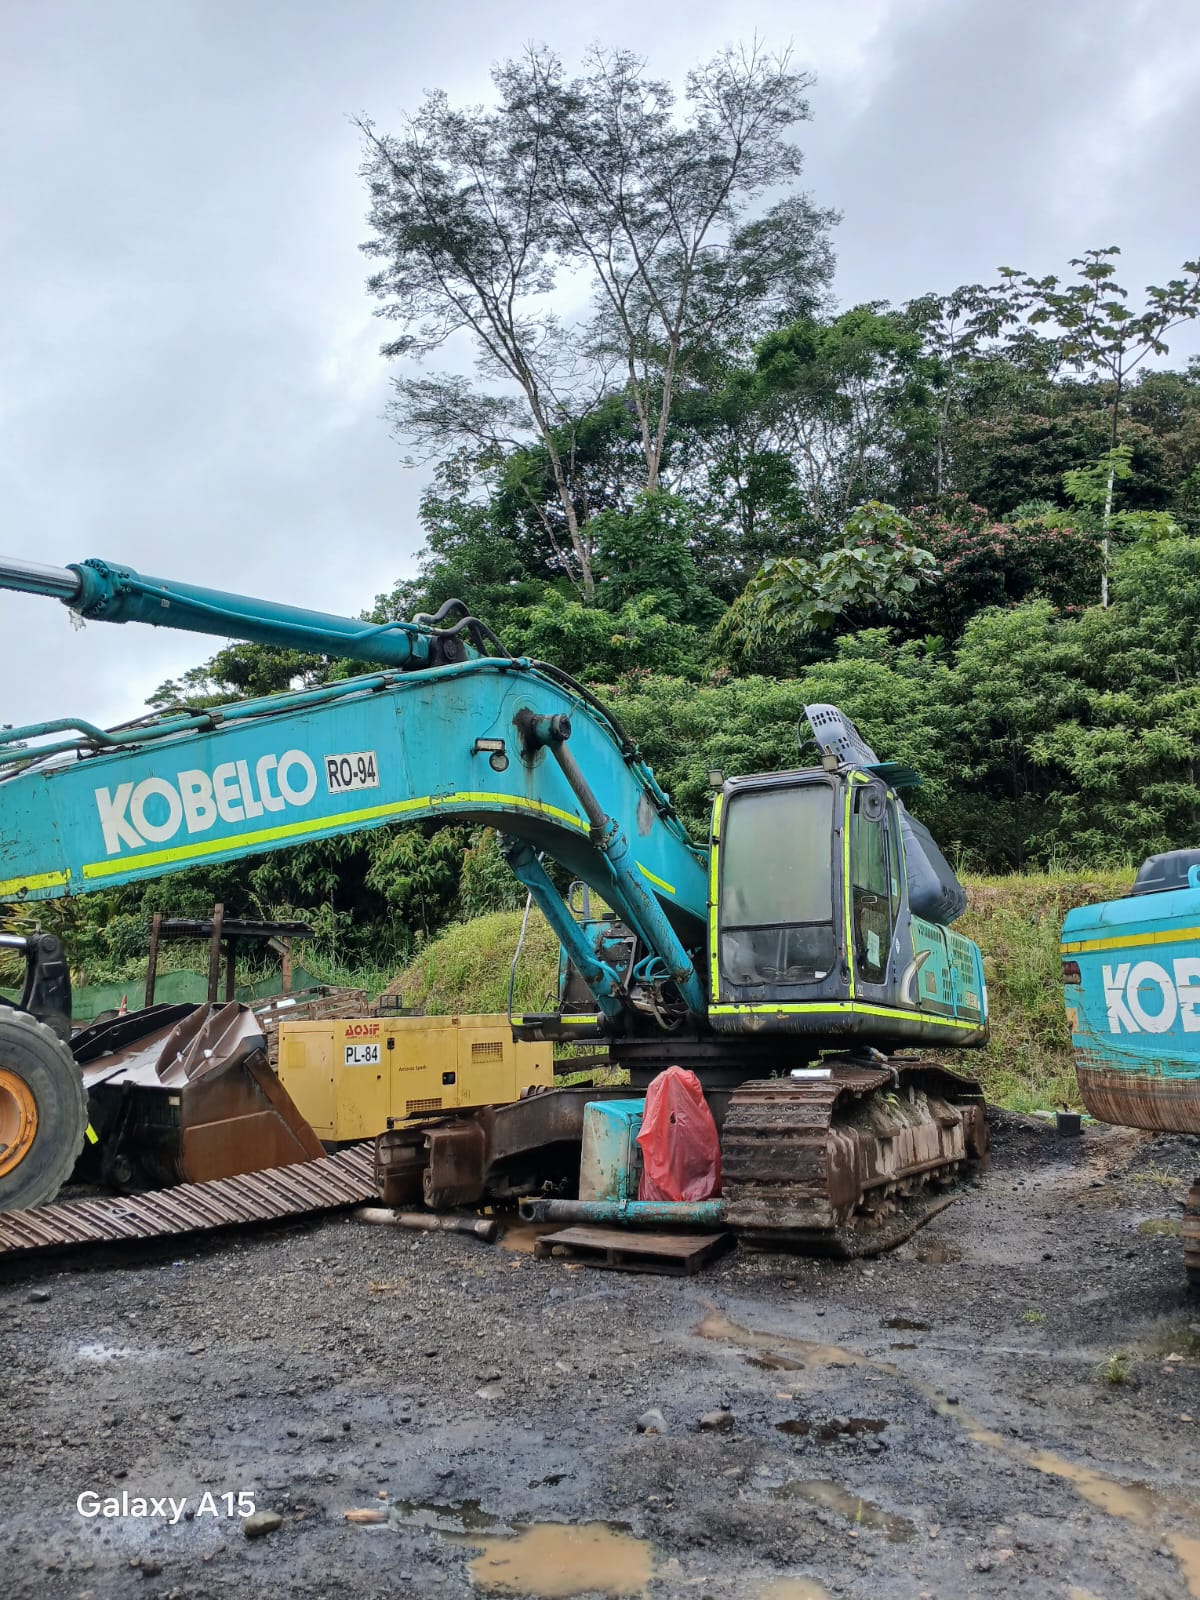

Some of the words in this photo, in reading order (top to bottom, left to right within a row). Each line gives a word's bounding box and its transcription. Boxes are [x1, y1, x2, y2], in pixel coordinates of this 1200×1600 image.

[327, 755, 376, 788] RO-94
[95, 749, 317, 855] KOBELCO
[346, 1045, 378, 1063] PL-84
